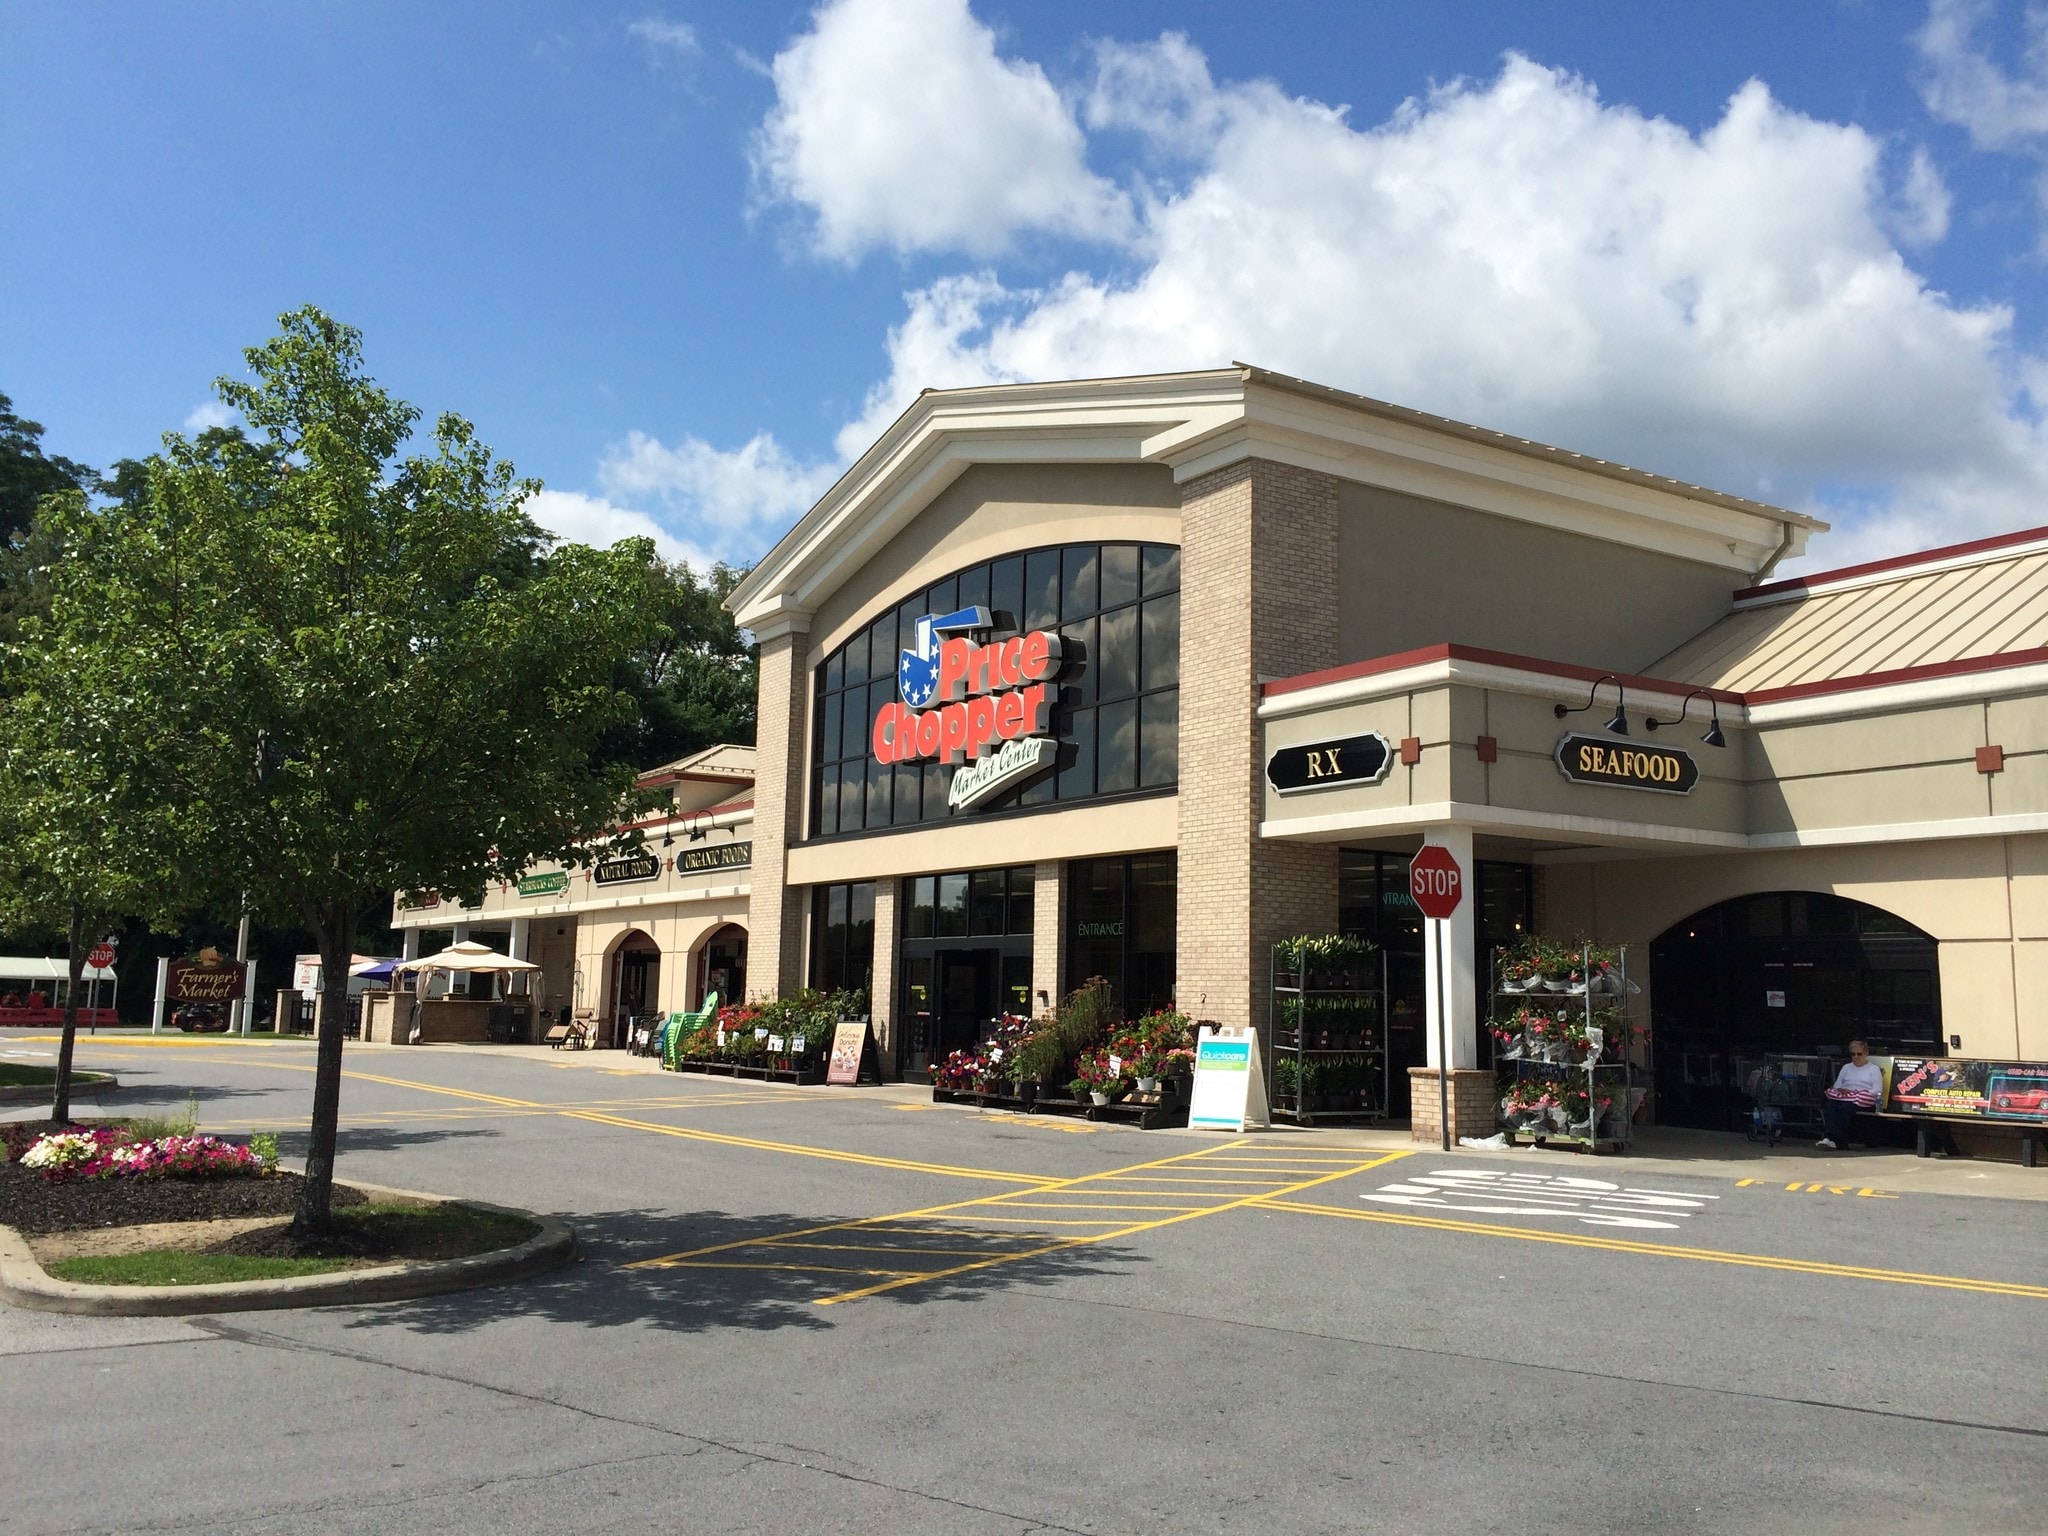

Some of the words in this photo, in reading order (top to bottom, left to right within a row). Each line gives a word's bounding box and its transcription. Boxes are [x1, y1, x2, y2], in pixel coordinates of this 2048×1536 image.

[940, 630, 1049, 701] Price
[873, 683, 1045, 765] Chopper
[953, 759, 995, 794] Market
[999, 740, 1041, 771] Center
[1306, 748, 1342, 779] RX
[1579, 745, 1681, 783] SEAFOOD
[600, 864, 630, 881] NATURAL
[630, 859, 653, 877] FOODS
[684, 850, 720, 870] ORGANIC
[721, 845, 749, 864] FOODS
[1414, 867, 1459, 896] STOP
[1382, 891, 1417, 906] NTRAN
[1078, 921, 1124, 936] ENTRANCE
[88, 950, 114, 962] STOP
[176, 968, 239, 985] Farmer's
[177, 980, 232, 999] Market
[1896, 1060, 1939, 1095] KEN'S
[1923, 1088, 1948, 1097] COMPLETE
[1949, 1089, 1963, 1097] AUTO
[1963, 1090, 1982, 1098] REPAIR
